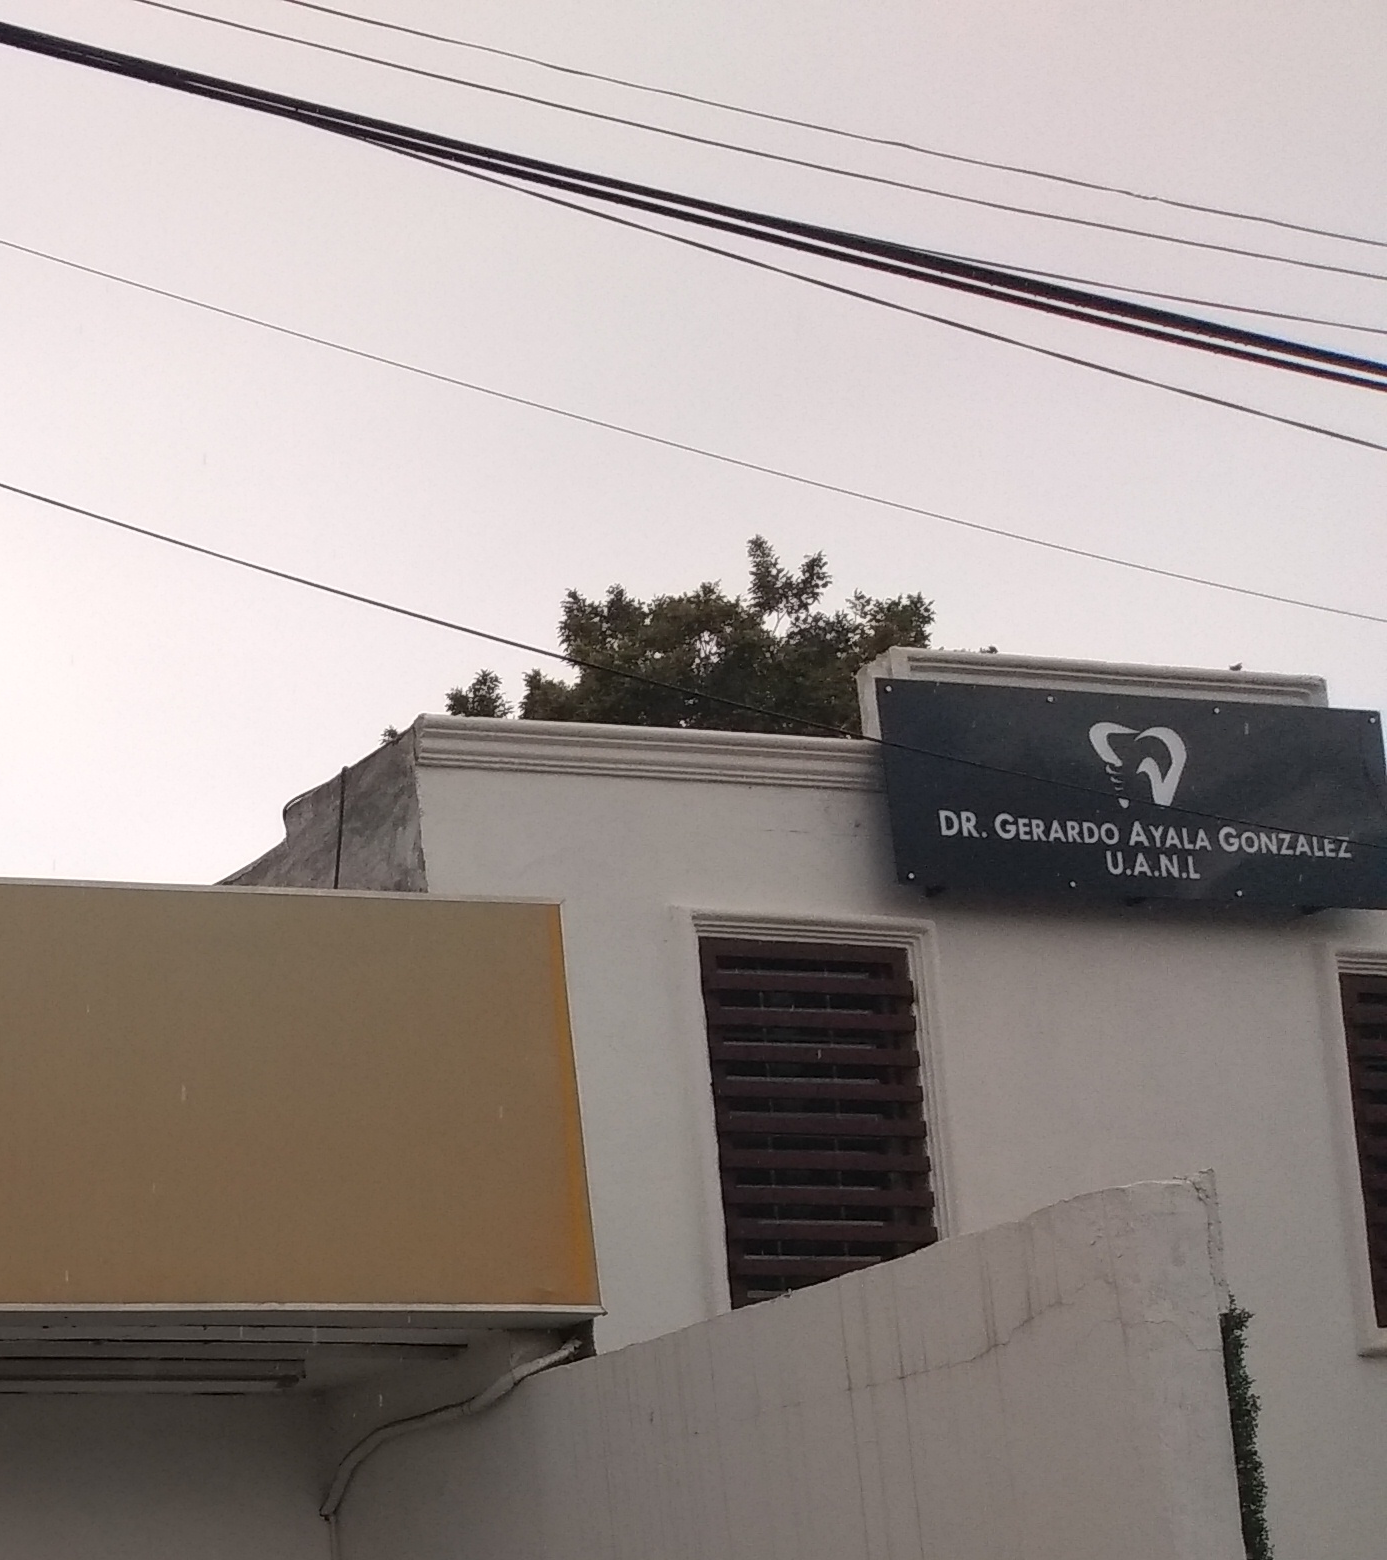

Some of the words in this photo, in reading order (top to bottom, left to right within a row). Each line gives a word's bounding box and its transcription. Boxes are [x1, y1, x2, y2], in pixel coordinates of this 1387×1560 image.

[938, 809, 988, 838] DR.
[994, 812, 1120, 845] GERARDO
[1129, 820, 1212, 851] AYALA
[1219, 826, 1352, 858] GONZALEZ
